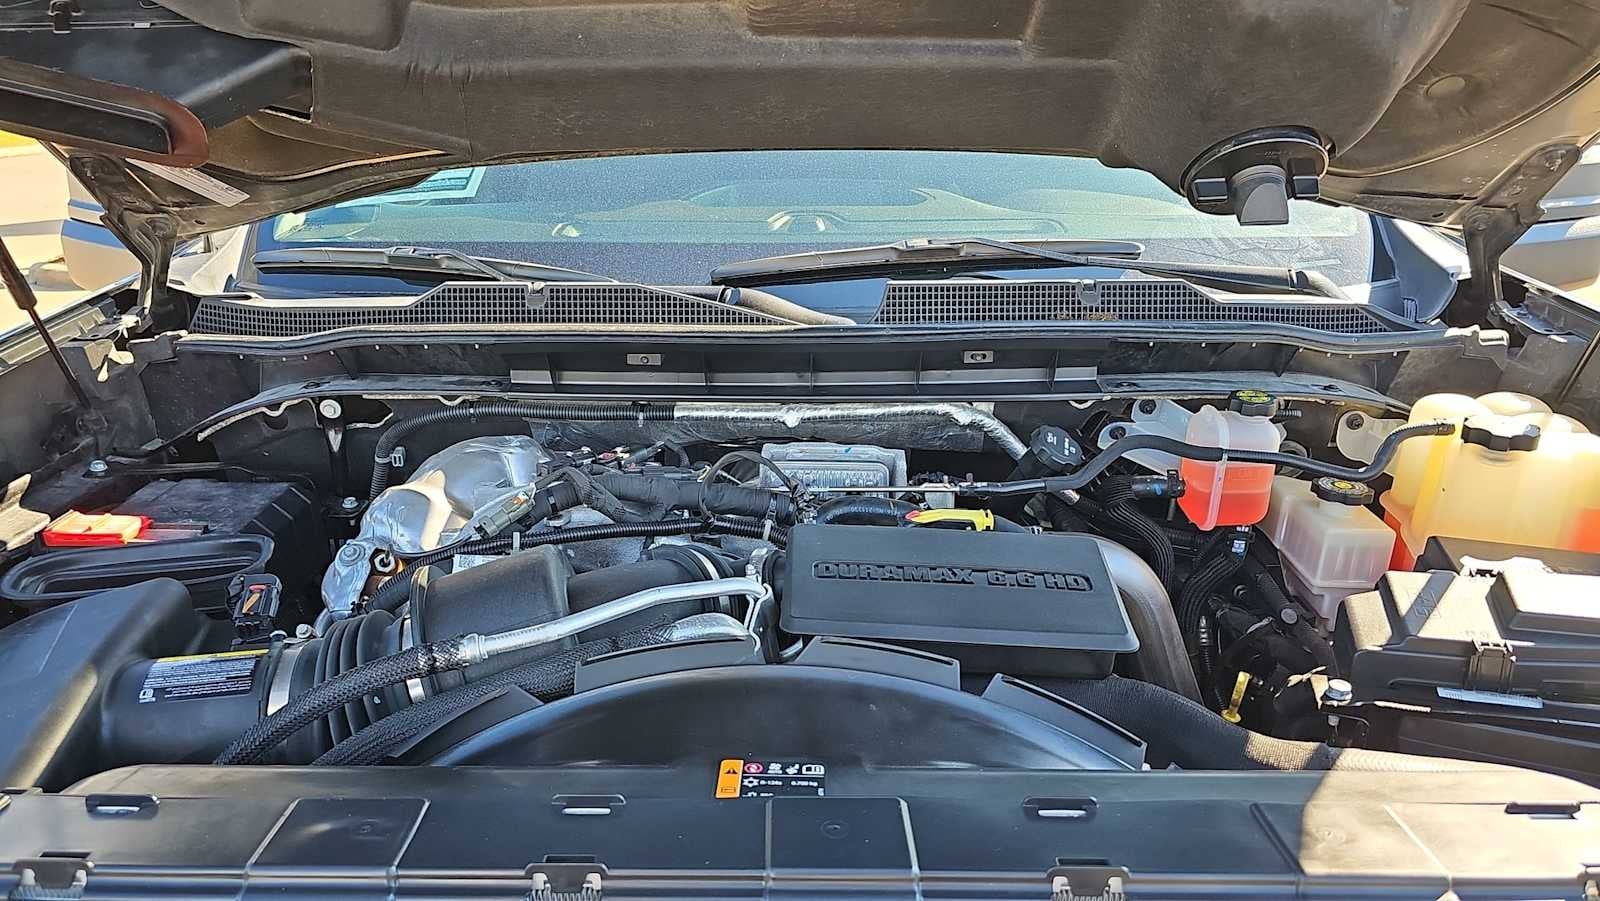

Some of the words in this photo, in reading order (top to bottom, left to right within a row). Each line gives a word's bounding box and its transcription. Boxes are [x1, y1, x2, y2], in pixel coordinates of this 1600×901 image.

[815, 562, 975, 585] DURAMAX
[986, 570, 1036, 588] 6.6
[1043, 572, 1092, 592] HD
